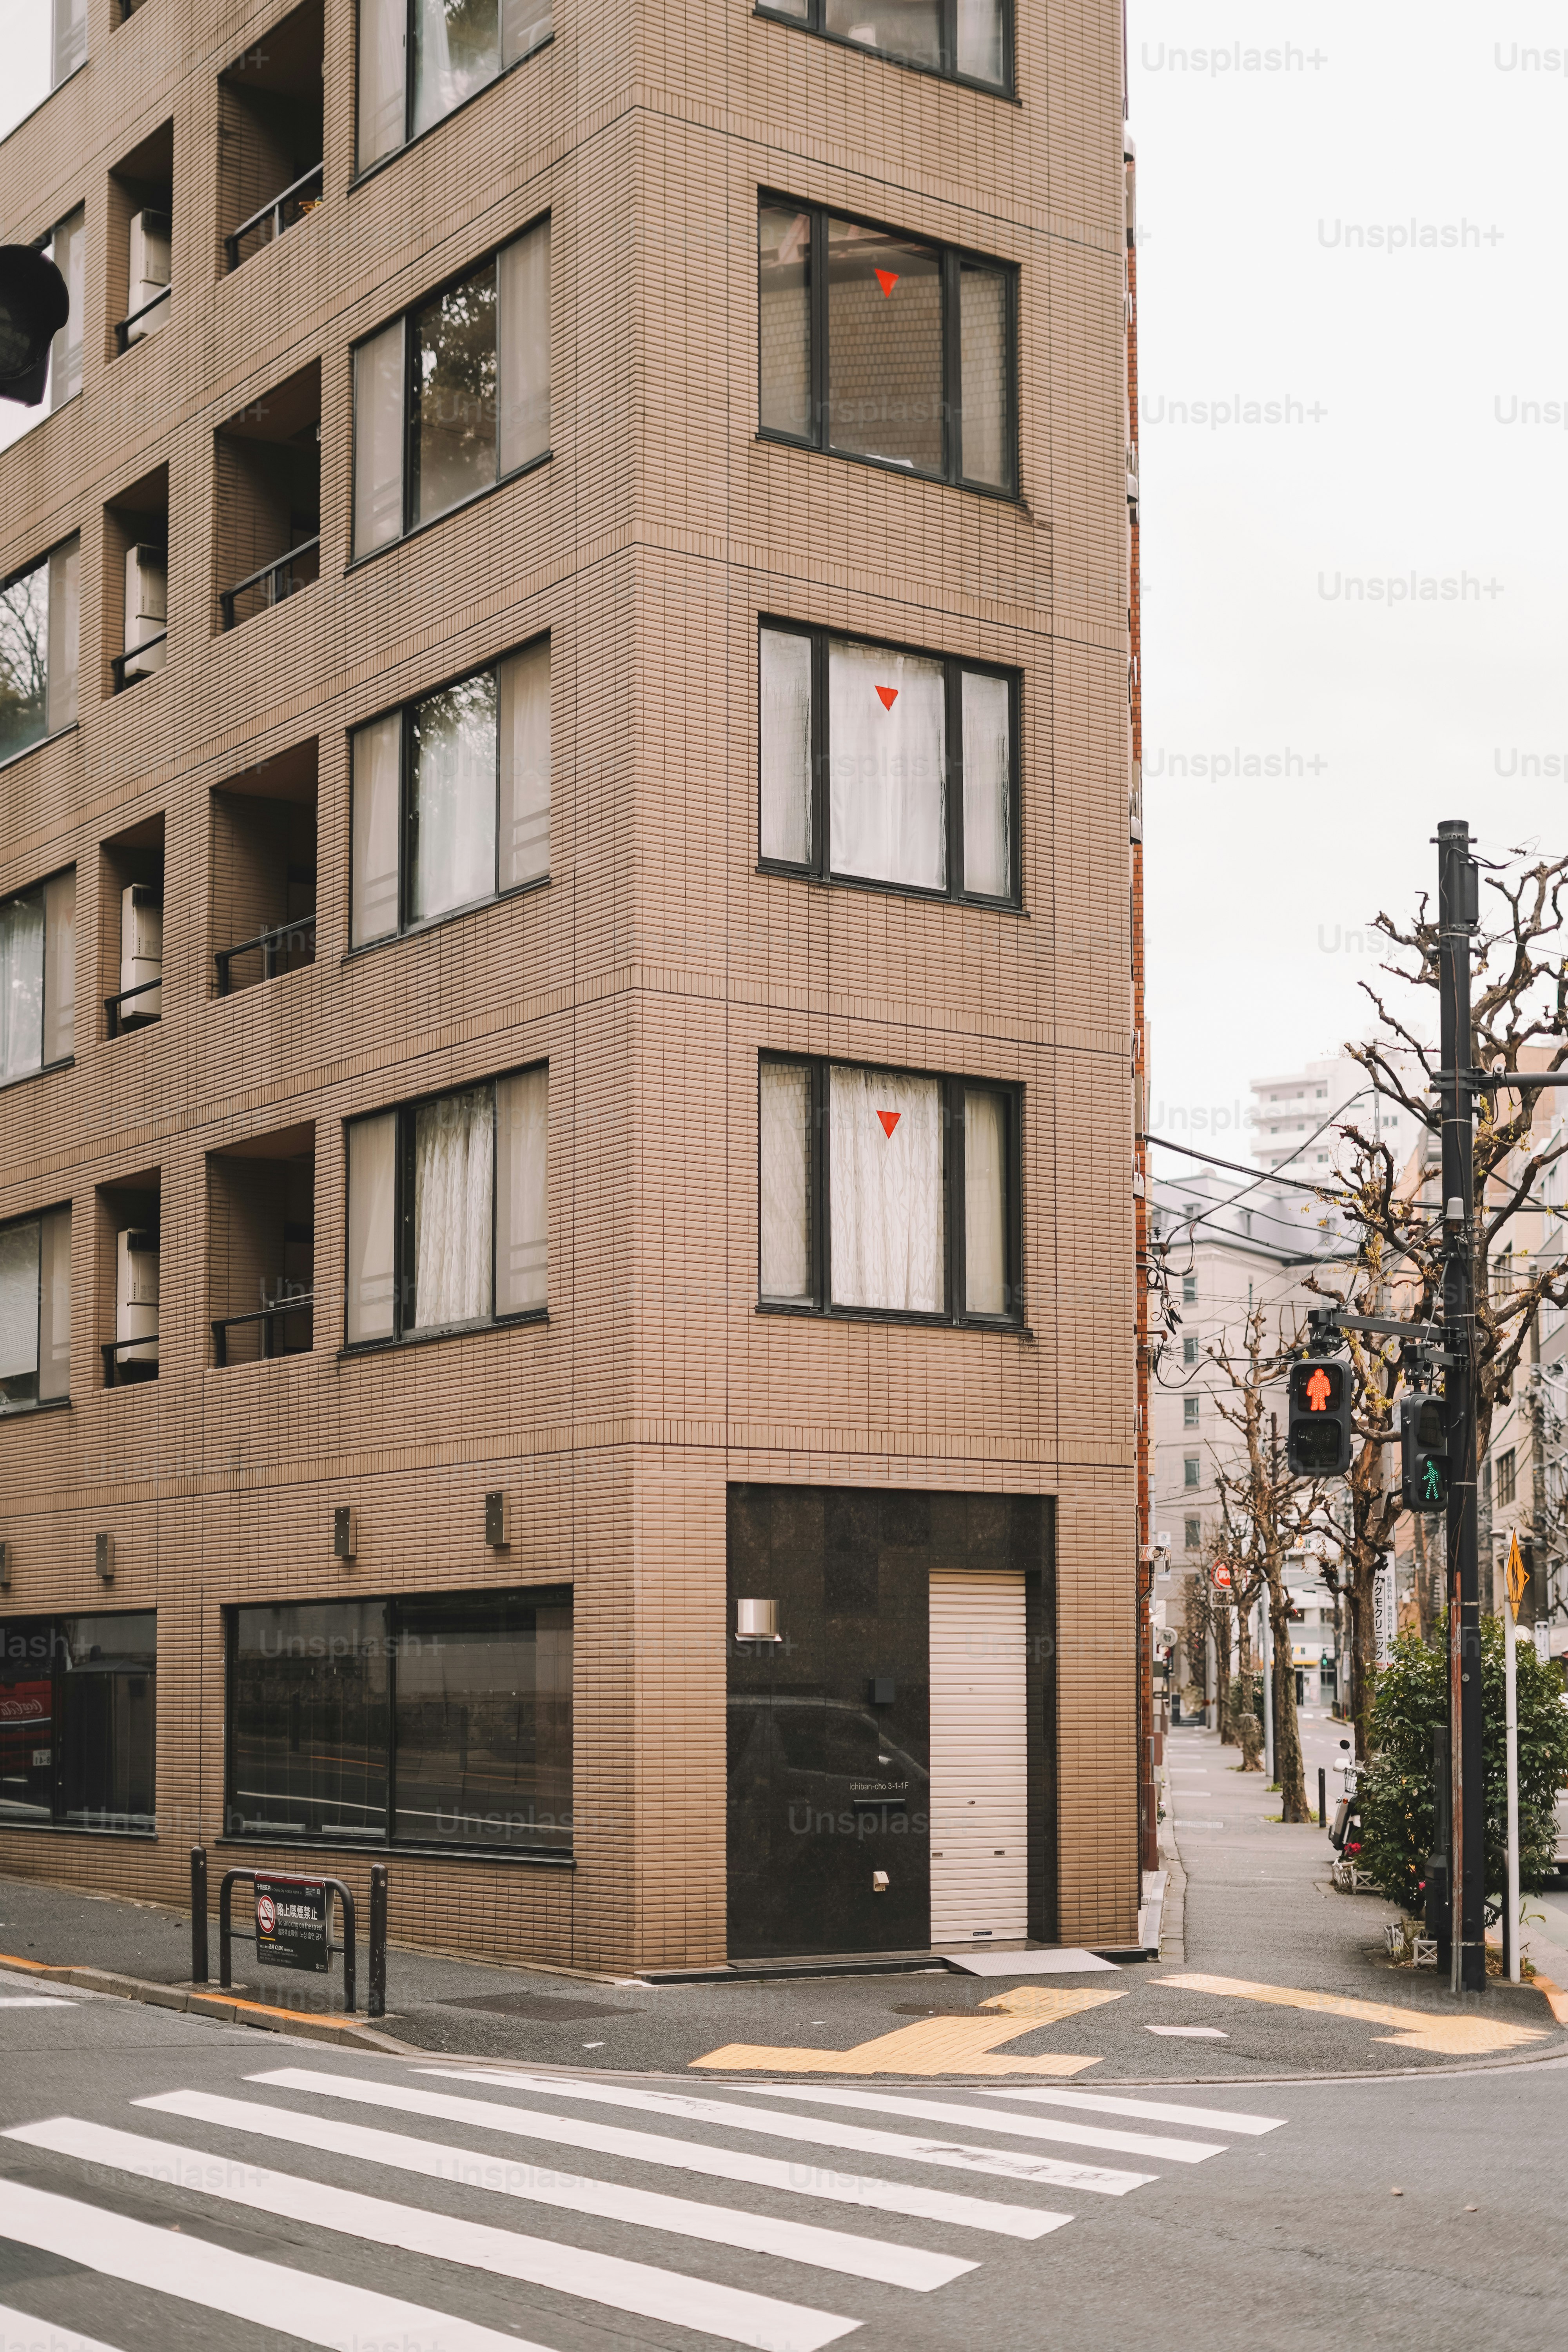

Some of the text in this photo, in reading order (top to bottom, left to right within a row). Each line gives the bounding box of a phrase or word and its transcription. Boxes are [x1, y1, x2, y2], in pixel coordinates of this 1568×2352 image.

[1374, 1575, 1384, 1660] ナグモクリニック
[277, 1903, 318, 1920] 路上喫煙禁止
[283, 1920, 298, 1930] smoking
